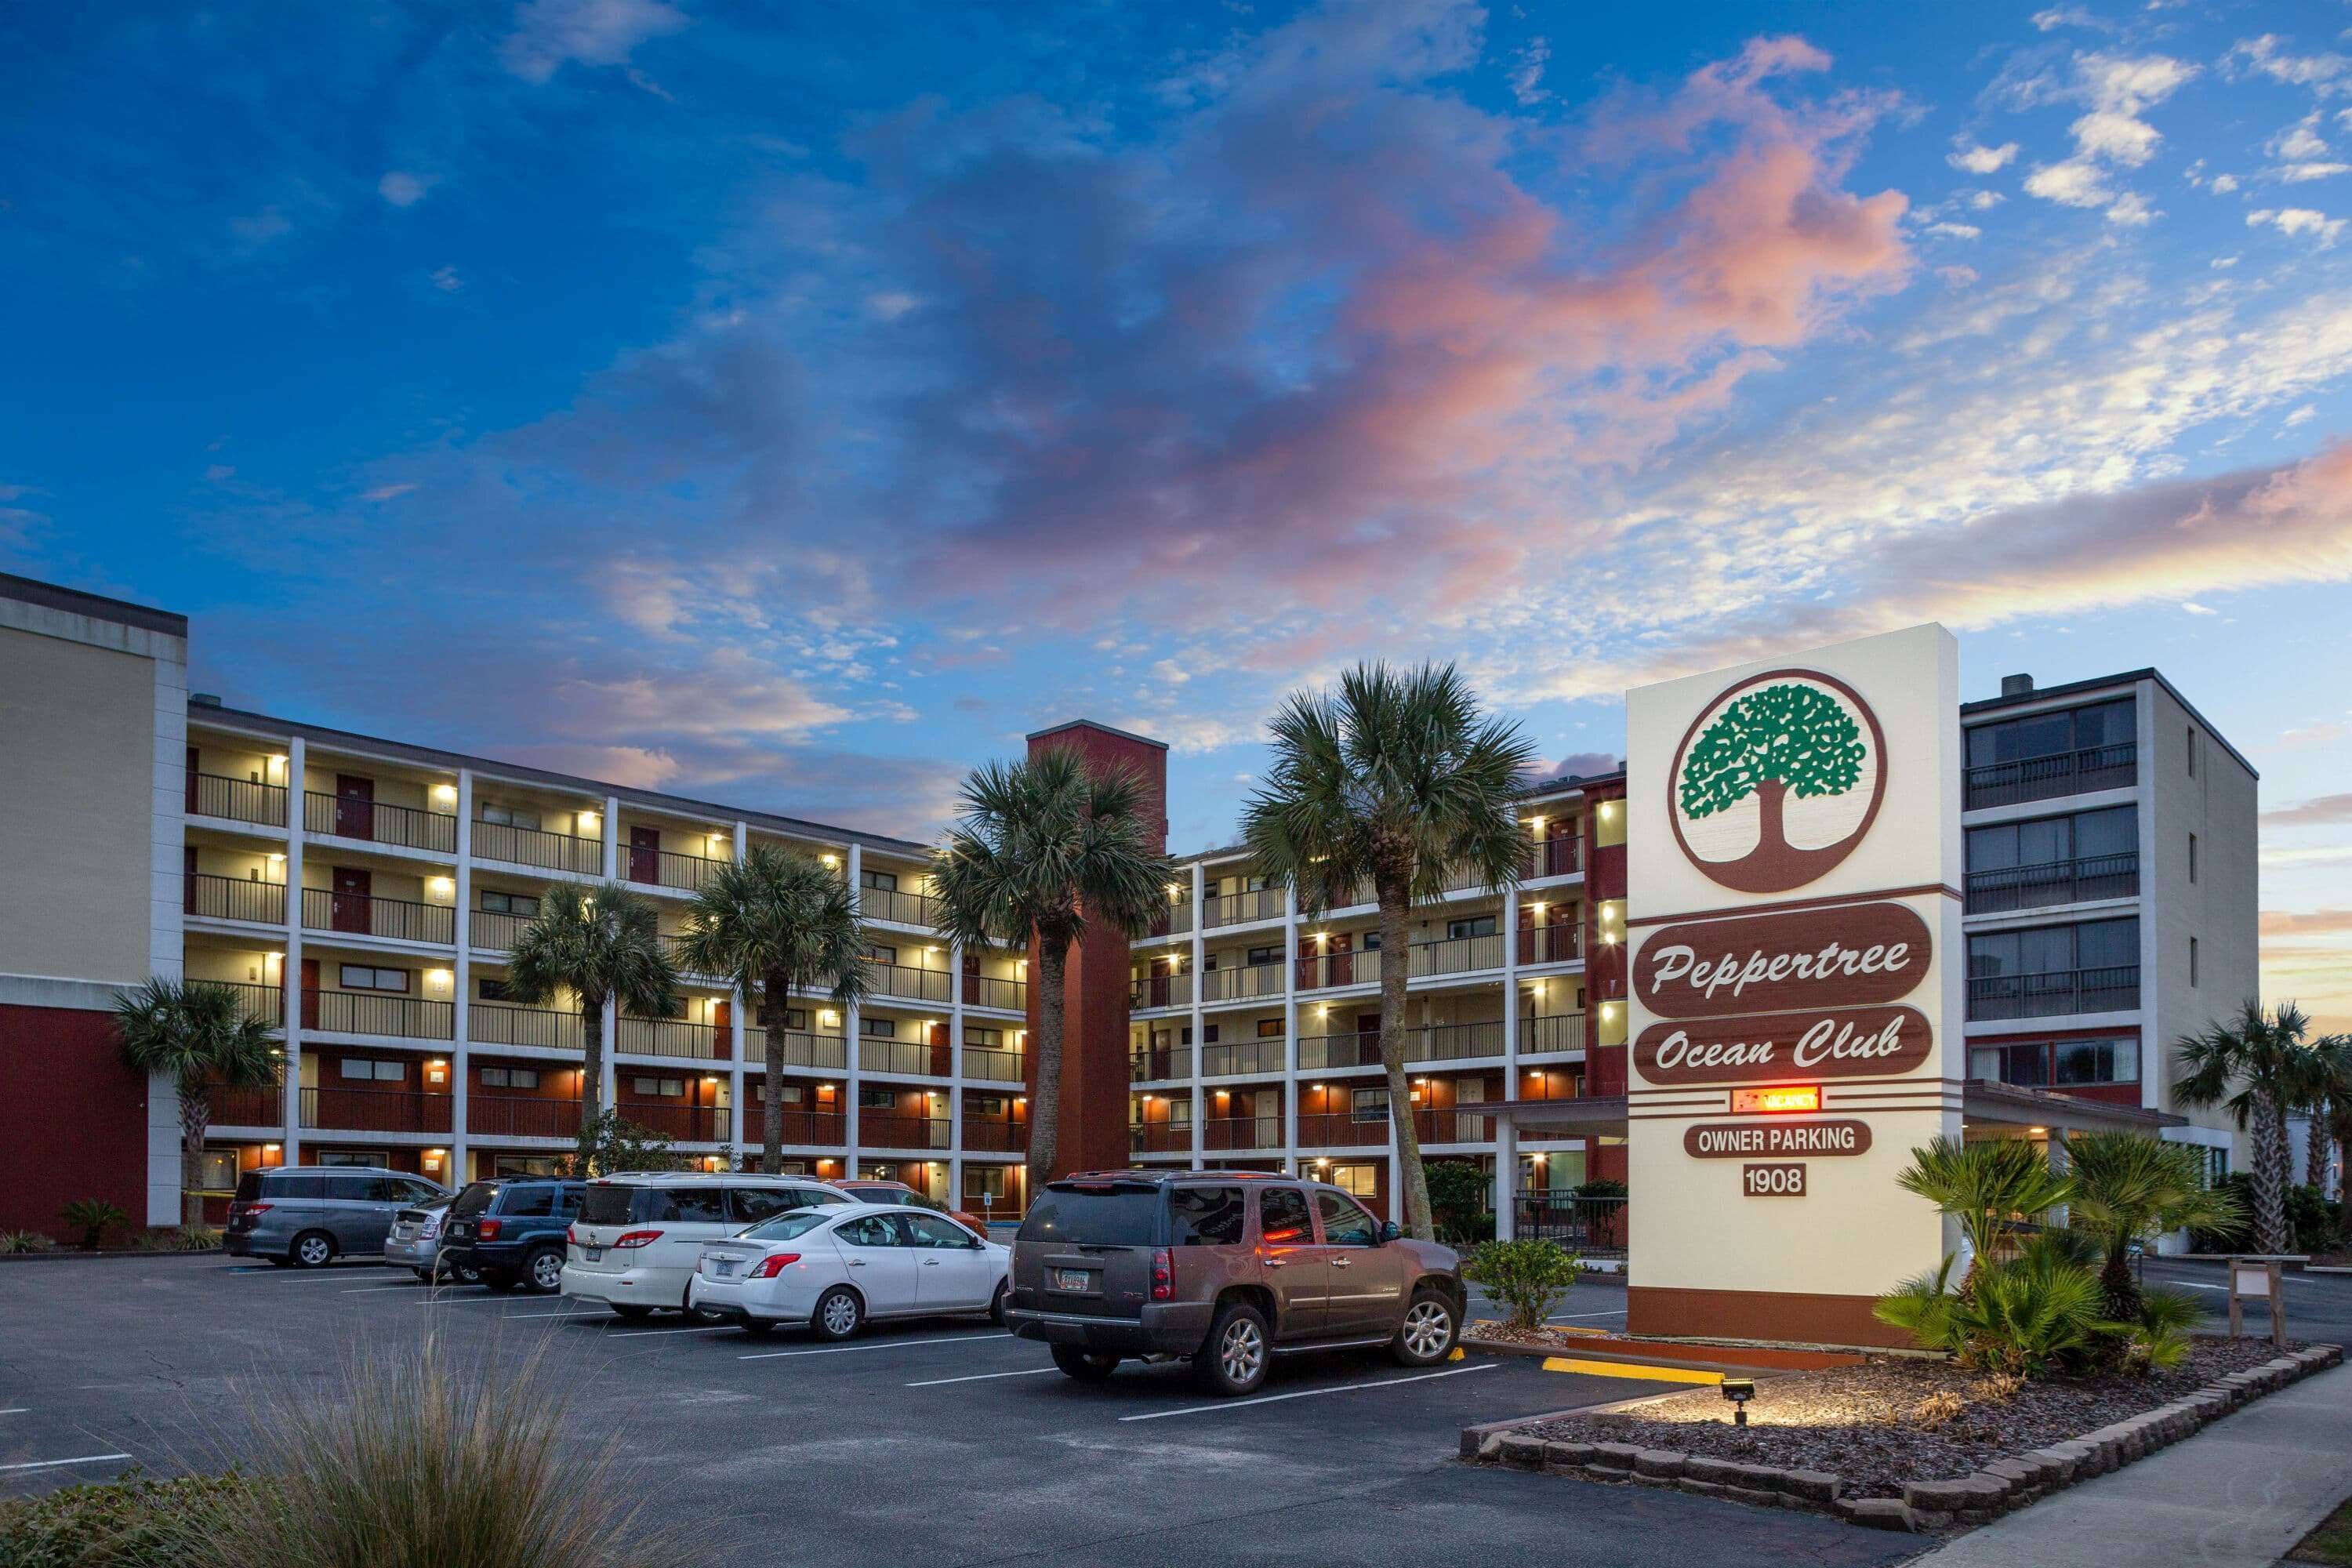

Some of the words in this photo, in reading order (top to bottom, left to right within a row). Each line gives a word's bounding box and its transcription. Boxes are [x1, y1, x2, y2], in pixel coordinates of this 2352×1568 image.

[1651, 942, 1911, 1000] Peppertree
[1656, 1030, 1775, 1069] Ocean
[1792, 1014, 1906, 1068] Club
[1763, 1093, 1817, 1108] VACANCY
[1697, 1129, 1765, 1152] OWNER
[1769, 1126, 1856, 1151] PARKING
[1745, 1168, 1803, 1194] 1908
